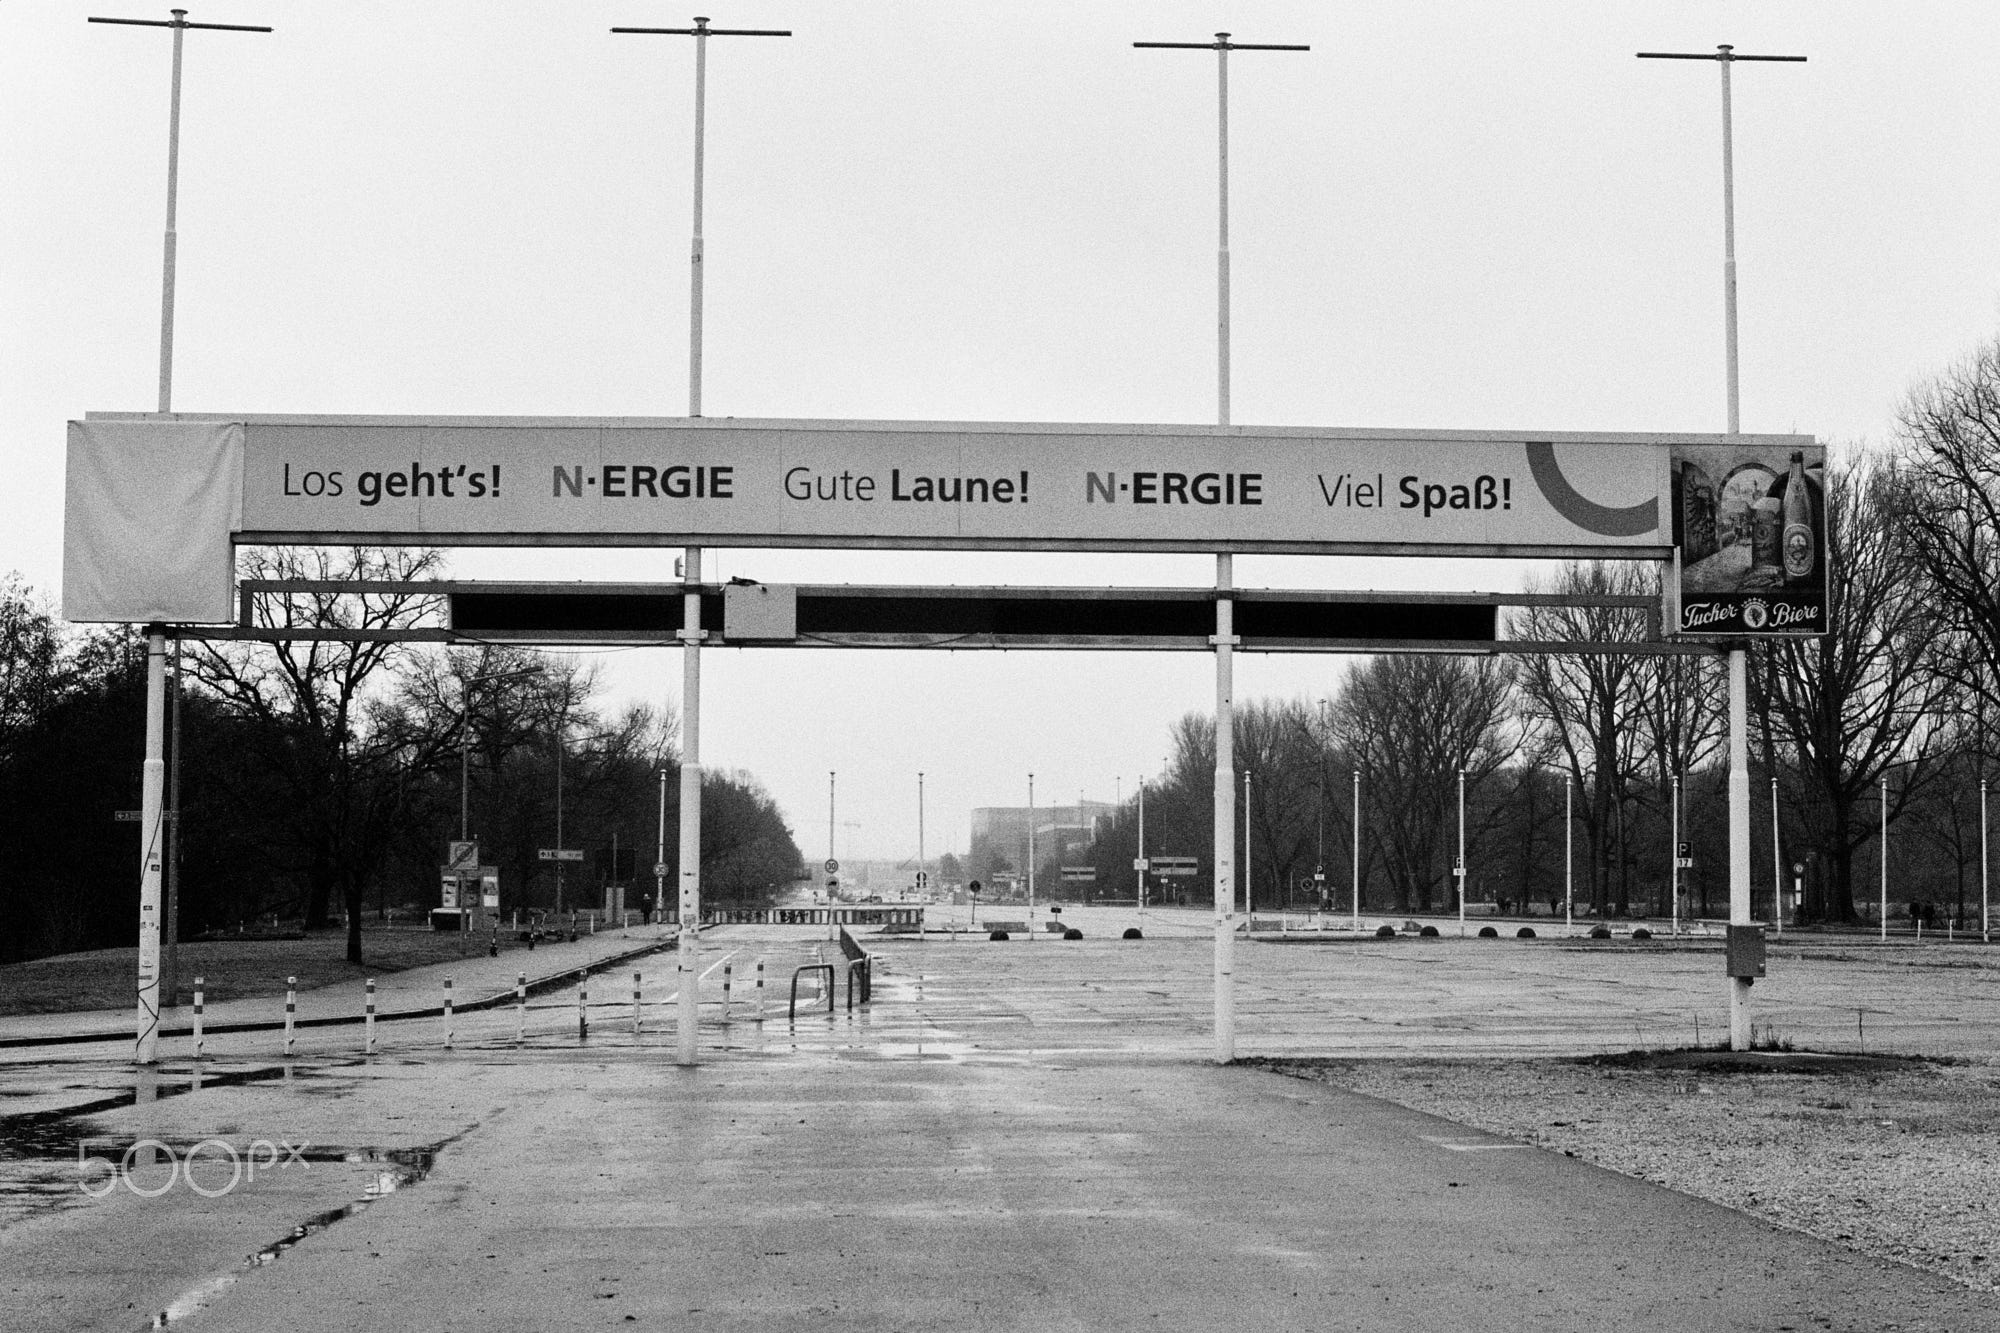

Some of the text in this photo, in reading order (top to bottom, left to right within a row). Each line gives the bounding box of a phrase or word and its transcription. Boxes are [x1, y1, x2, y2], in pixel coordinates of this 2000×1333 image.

[284, 463, 343, 498] Los
[783, 466, 1029, 503] Gute Laune!
[1317, 473, 1512, 518] Viel Spaß!
[1769, 602, 1819, 628] Biere
[1678, 843, 1688, 857] P
